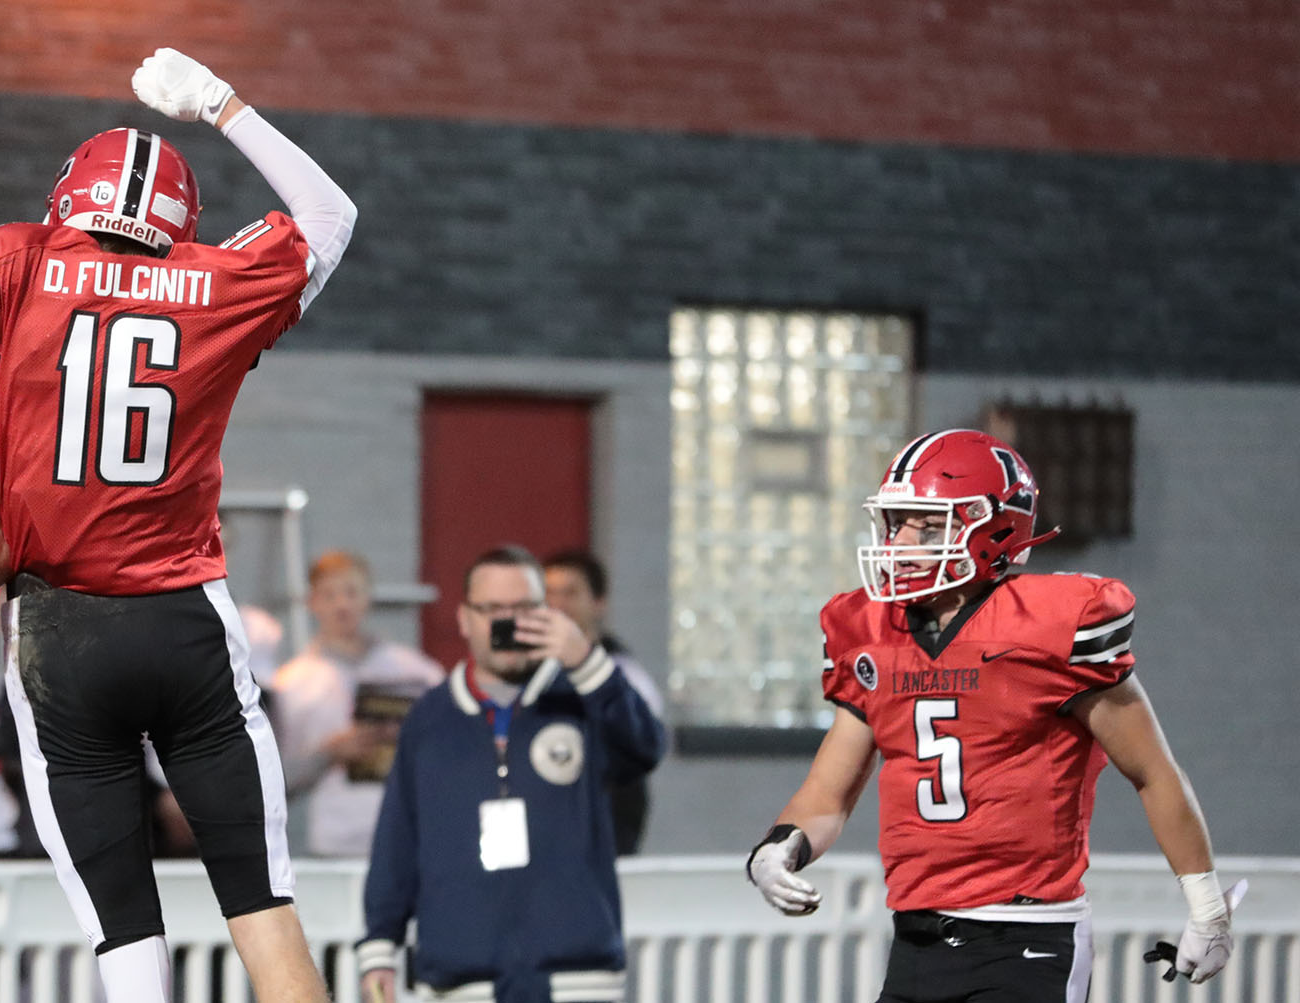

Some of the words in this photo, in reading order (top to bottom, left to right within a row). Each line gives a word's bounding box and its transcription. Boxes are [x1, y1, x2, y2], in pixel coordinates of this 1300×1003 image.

[91, 214, 158, 244] Riddell
[43, 258, 69, 294] D.
[75, 260, 212, 306] FULCINITI
[52, 308, 182, 487] 16
[892, 668, 980, 694] LANCASTER
[913, 698, 968, 822] 5
